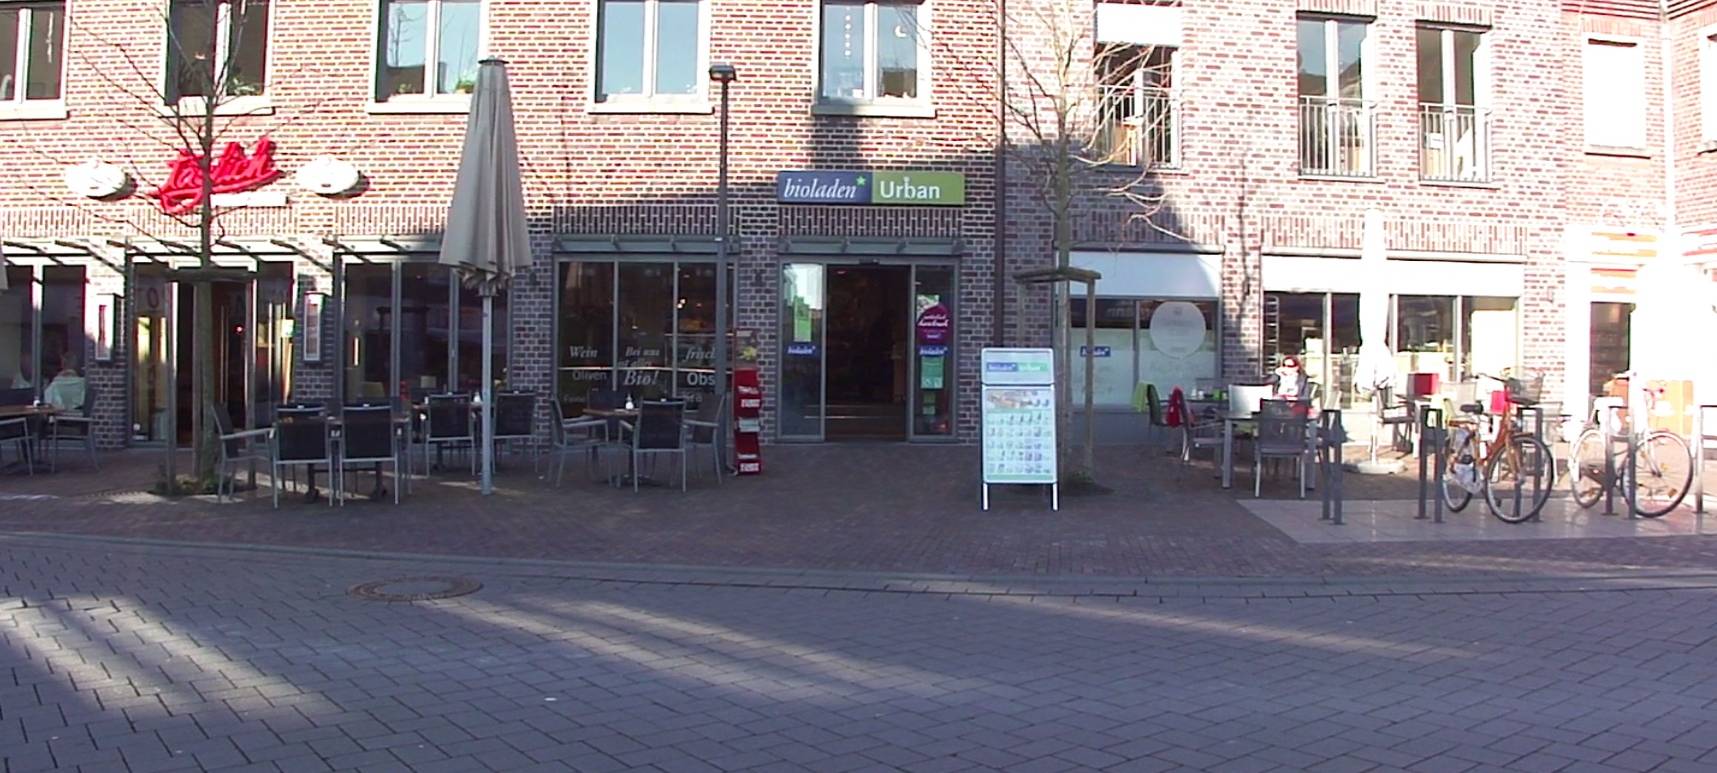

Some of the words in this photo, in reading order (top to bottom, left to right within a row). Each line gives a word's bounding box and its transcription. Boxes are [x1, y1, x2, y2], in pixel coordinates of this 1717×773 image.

[783, 178, 857, 199] bioladen
[880, 179, 941, 199] Urban
[569, 345, 598, 359] Wein
[572, 370, 608, 382] Oliven
[623, 370, 659, 386] Bio!
[686, 372, 716, 386] Obs
